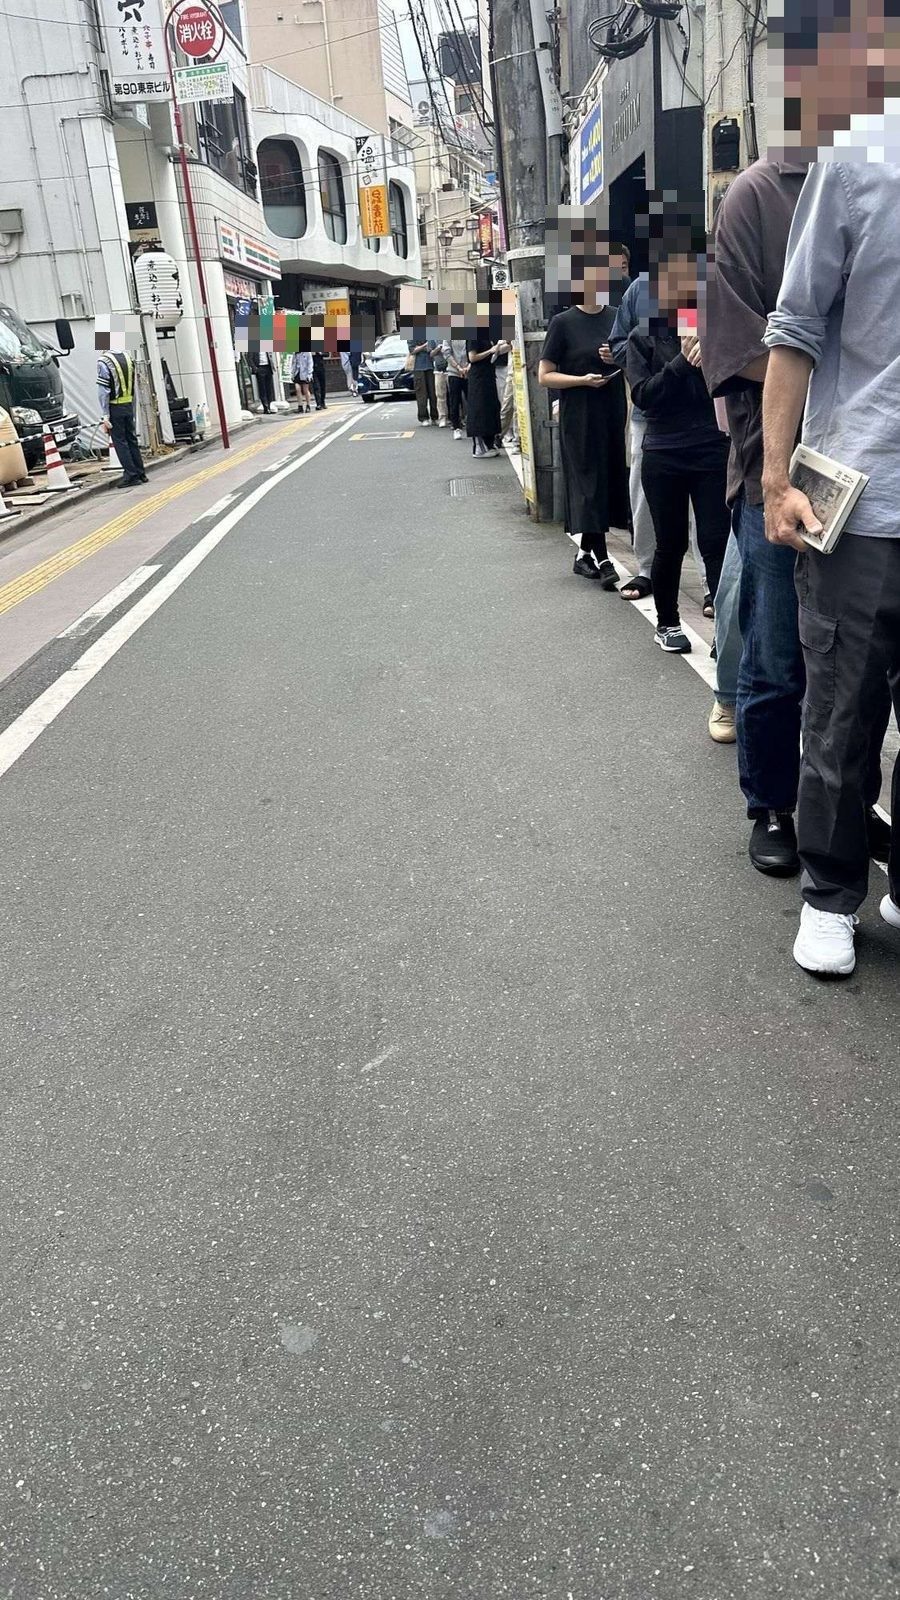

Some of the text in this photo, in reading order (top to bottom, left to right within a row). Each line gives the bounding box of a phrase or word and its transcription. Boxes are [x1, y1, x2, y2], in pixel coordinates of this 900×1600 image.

[178, 20, 214, 43] 消火栓
[114, 81, 170, 96] 第90東京ビル
